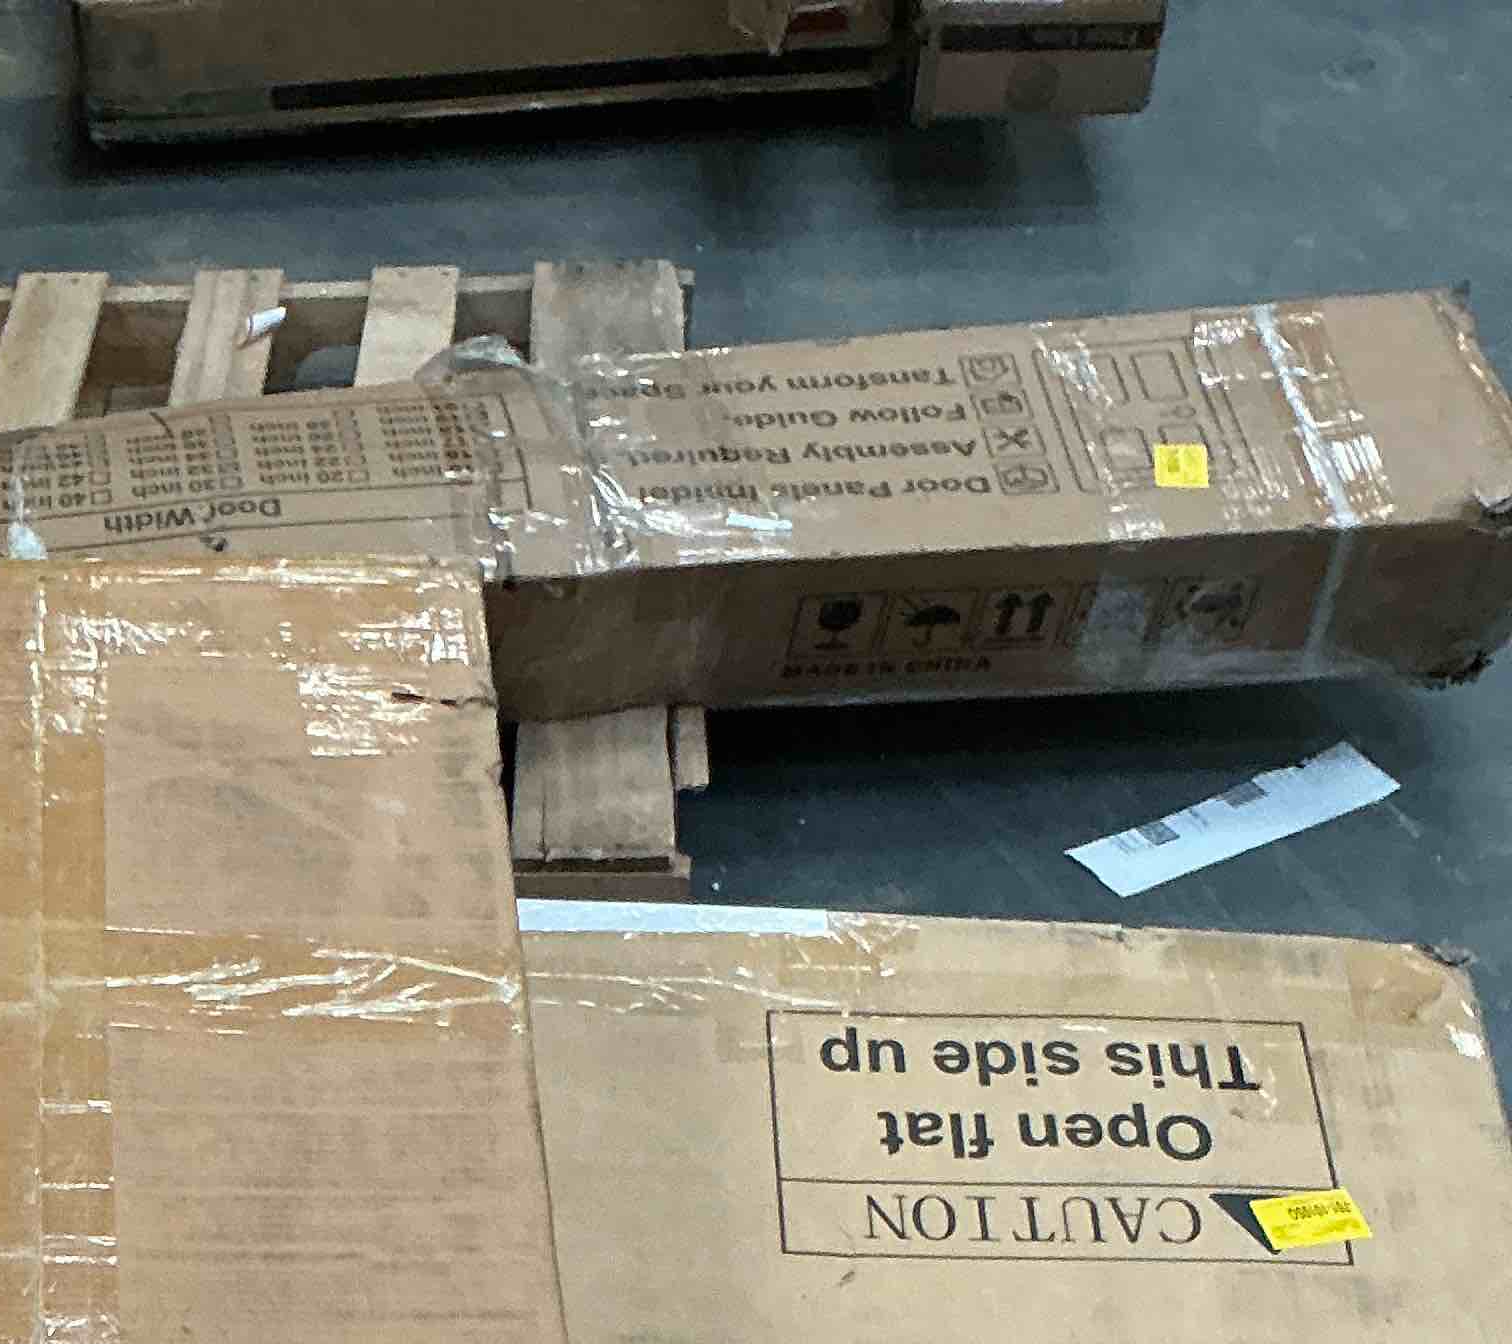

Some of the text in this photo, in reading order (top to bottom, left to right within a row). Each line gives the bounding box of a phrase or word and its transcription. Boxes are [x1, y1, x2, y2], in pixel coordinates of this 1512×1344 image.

[849, 404, 966, 423] Follow
[803, 439, 976, 463] Assembly
[906, 476, 991, 495] Door
[103, 498, 282, 534] Door Width
[819, 1027, 1262, 1092] This side up
[879, 1109, 1214, 1163] Open flat
[864, 1194, 1202, 1245] CAUTION
